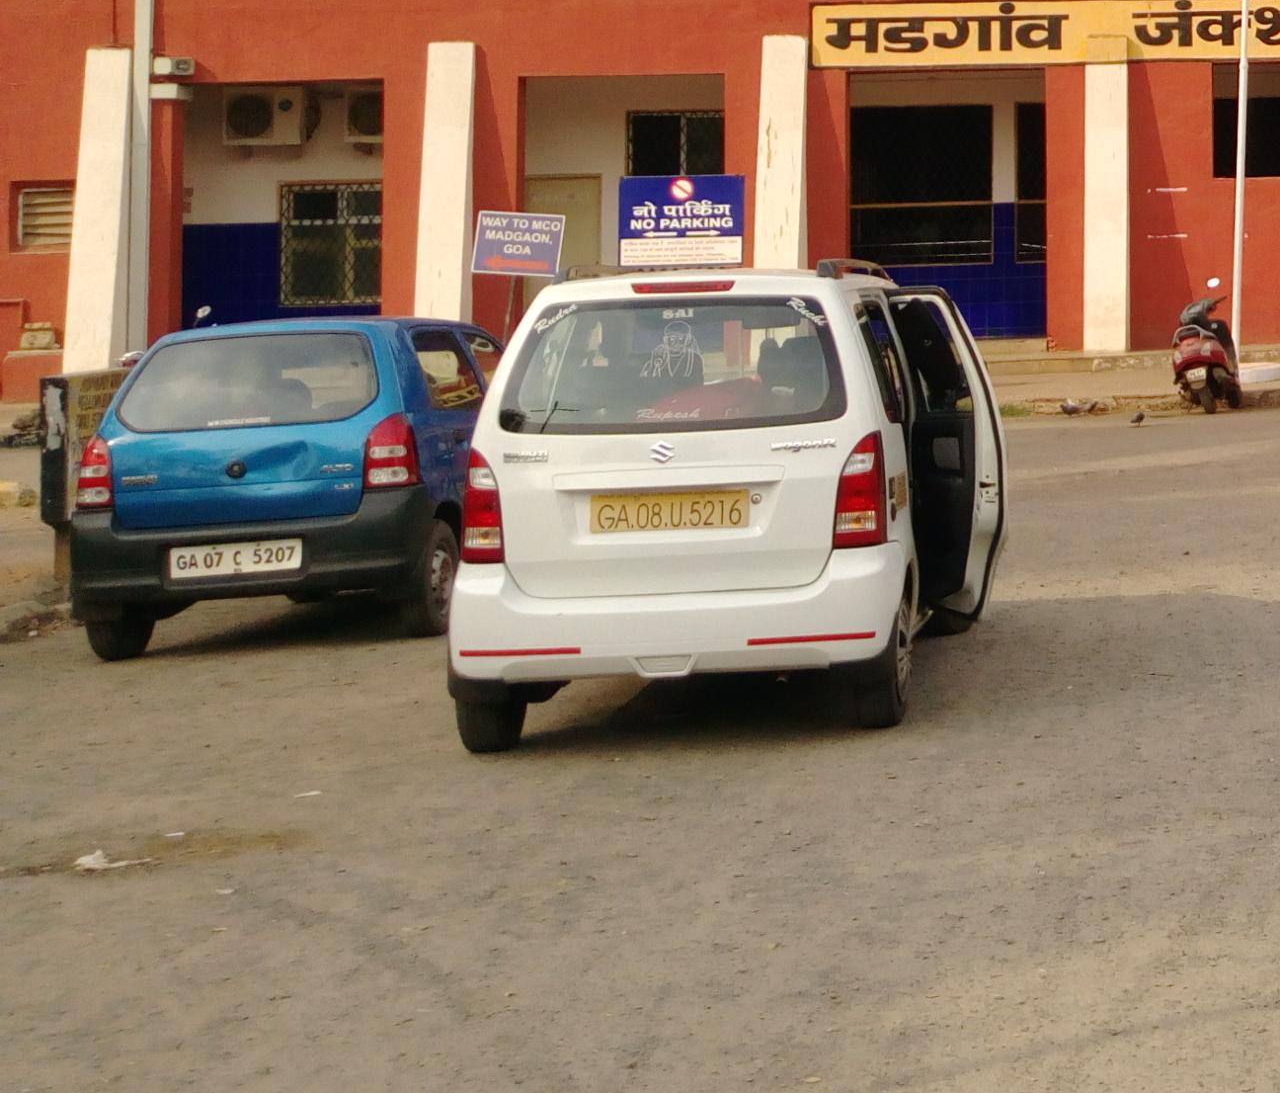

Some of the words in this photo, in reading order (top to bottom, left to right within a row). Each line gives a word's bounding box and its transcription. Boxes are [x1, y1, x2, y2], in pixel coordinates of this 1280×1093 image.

[824, 1, 1070, 54] मडगांव
[632, 200, 657, 218] नो
[482, 216, 510, 228] WAY
[511, 217, 529, 229] TO
[531, 219, 561, 231] MCO
[630, 219, 655, 231] NO
[660, 216, 733, 230] PARKING
[503, 244, 531, 256] GOA
[662, 308, 694, 320] SAI
[597, 497, 743, 531] GA.08.U.5216
[176, 553, 198, 571] GA
[203, 551, 224, 569] 07
[233, 550, 242, 566] C
[252, 546, 297, 565] 5207
